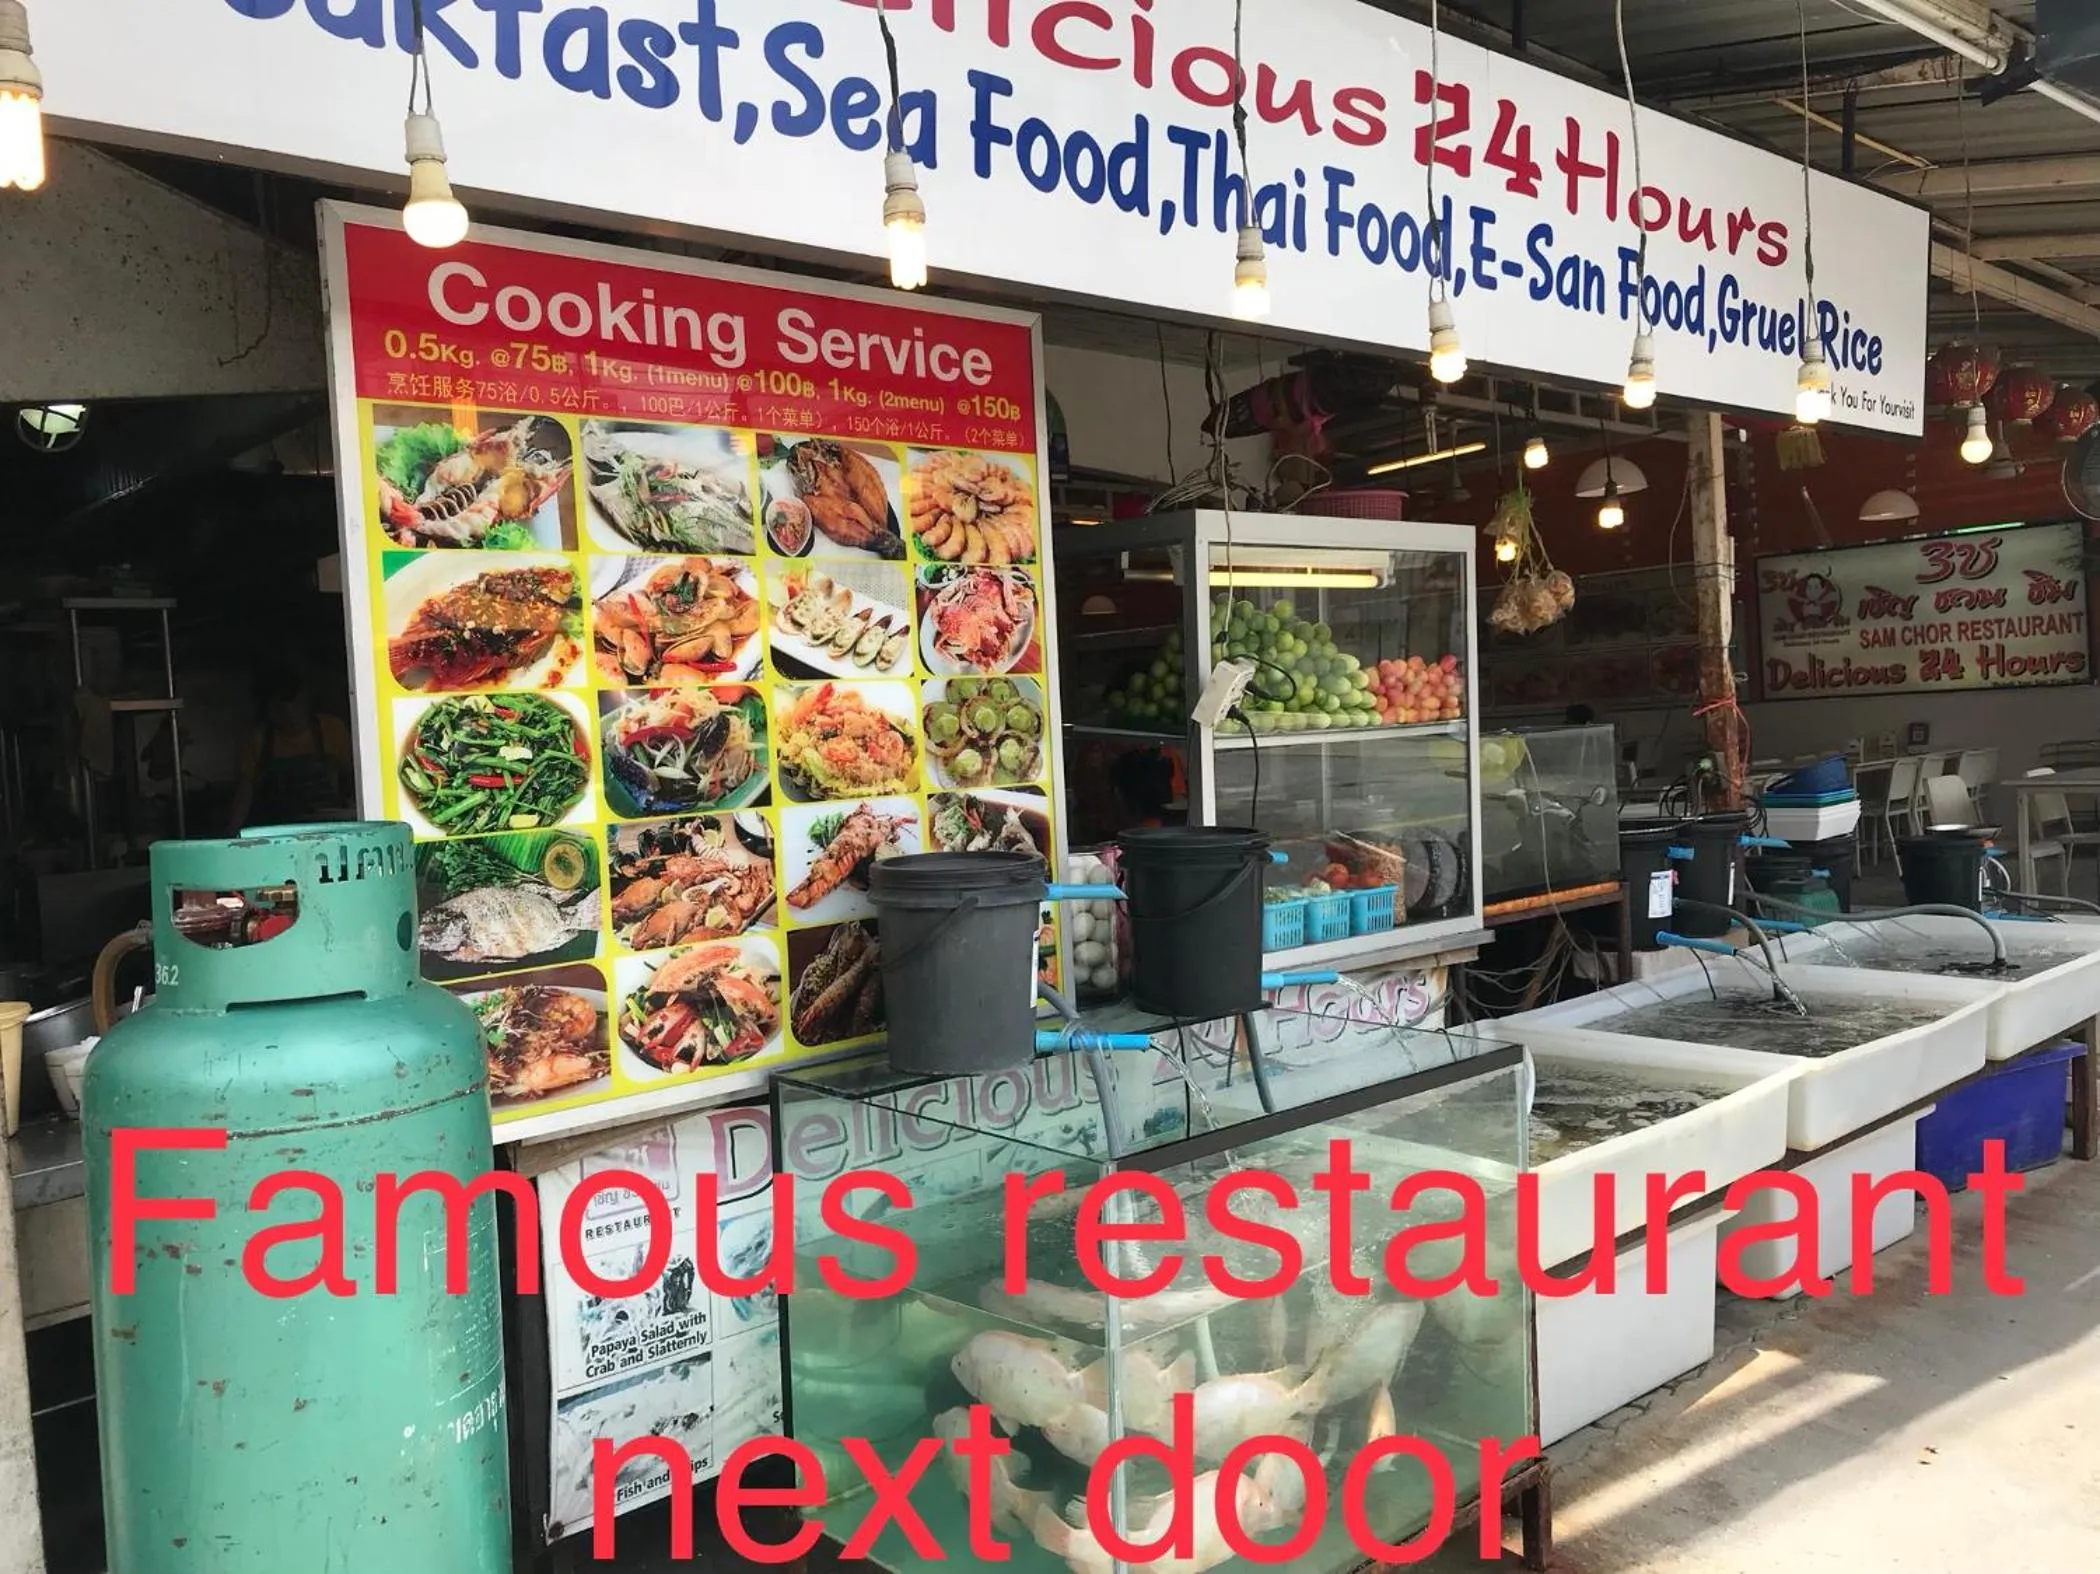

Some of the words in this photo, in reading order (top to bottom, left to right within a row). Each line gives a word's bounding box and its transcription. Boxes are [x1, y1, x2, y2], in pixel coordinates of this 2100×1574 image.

[839, 0, 1386, 146] cious
[1414, 70, 1542, 197] 24
[1556, 115, 1788, 267] Hours
[427, 261, 745, 368] Cooking
[777, 308, 992, 385] Service
[1817, 300, 1883, 375] Rice
[385, 330, 480, 369] 0.5Kg.
[584, 350, 637, 383] 1Kg.
[648, 365, 728, 392] (1menu)
[828, 378, 872, 407] 1Kg.
[880, 391, 944, 415] (2menu)
[1840, 386, 1859, 409] You
[1862, 391, 1877, 412] For
[1860, 626, 1896, 649] SAM
[1901, 623, 1950, 646] CHOR
[1957, 612, 2084, 642] RESTAURANT
[1766, 652, 1906, 691] Delicious
[1919, 648, 1965, 681] 24
[1975, 643, 2086, 681] Hours
[586, 1207, 680, 1239] RESTAURT
[586, 1361, 615, 1378] Crab
[620, 1350, 643, 1367] and
[647, 1331, 707, 1359] Slatternly
[591, 1336, 636, 1358] Papaya
[641, 1321, 675, 1342] Salad
[679, 1312, 707, 1330] with
[616, 1481, 643, 1501] Fish
[648, 1472, 670, 1490] and
